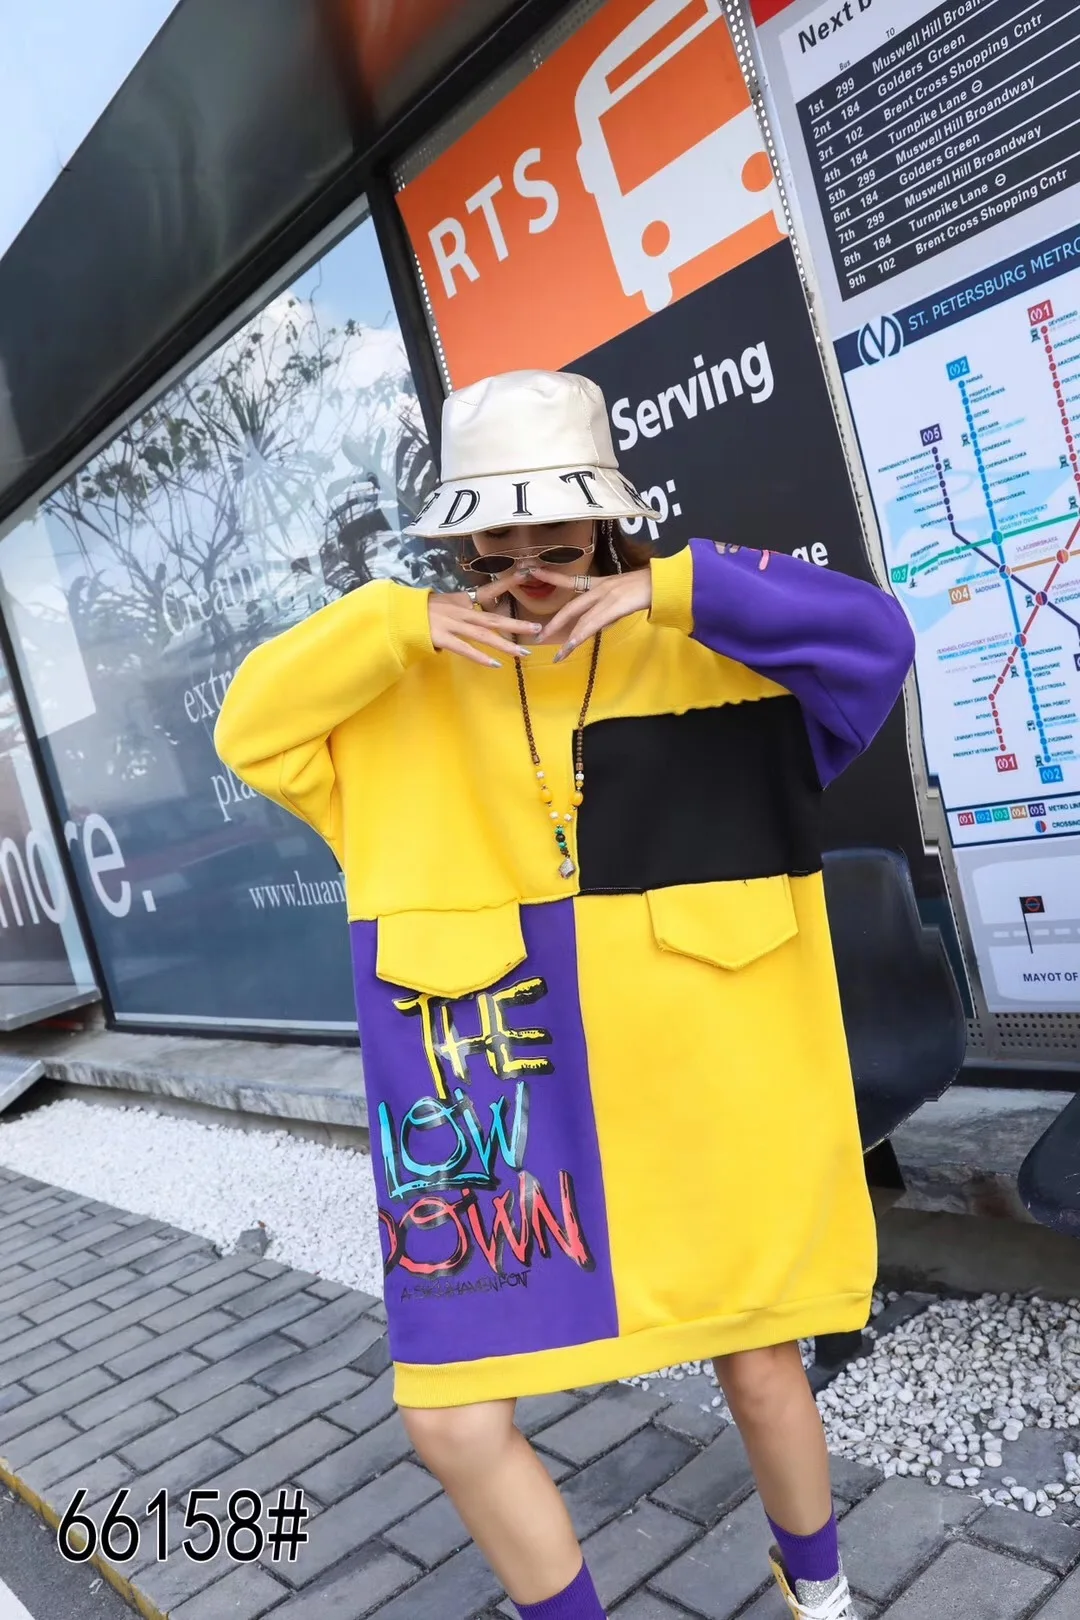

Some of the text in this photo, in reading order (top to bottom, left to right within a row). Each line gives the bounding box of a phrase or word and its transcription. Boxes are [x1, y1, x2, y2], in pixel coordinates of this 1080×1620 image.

[797, 1, 853, 54] Next
[808, 98, 825, 117] 1st
[835, 77, 855, 100] 299
[872, 34, 920, 74] Muswell
[921, 17, 942, 42] Hill
[885, 27, 896, 39] TO
[812, 33, 966, 140] 2nt 184 Golders Green
[817, 14, 1042, 163] 3rt 102 Brent Cross Shopping Cntr
[824, 89, 967, 184] 4th 184 Turnpike Lane
[828, 76, 1035, 204] 5th 299 Muswell Hill Broandway
[832, 132, 981, 224] 6nt 184 Golders Green
[838, 124, 1042, 245] 7th 299 Muswell Hill Broandway
[427, 147, 561, 299] RTS
[843, 183, 989, 267] 8th 184 Turnpike Lane
[848, 168, 1068, 290] 9th 102 Brent Cross Shopping Cntr
[908, 311, 929, 331] ST.
[932, 264, 1028, 320] PETERSBURG
[611, 340, 775, 451] Serving
[184, 667, 241, 724] extr
[1022, 972, 1078, 982] MAYOT OF
[392, 975, 556, 1102] THE
[378, 1080, 530, 1200] LOW
